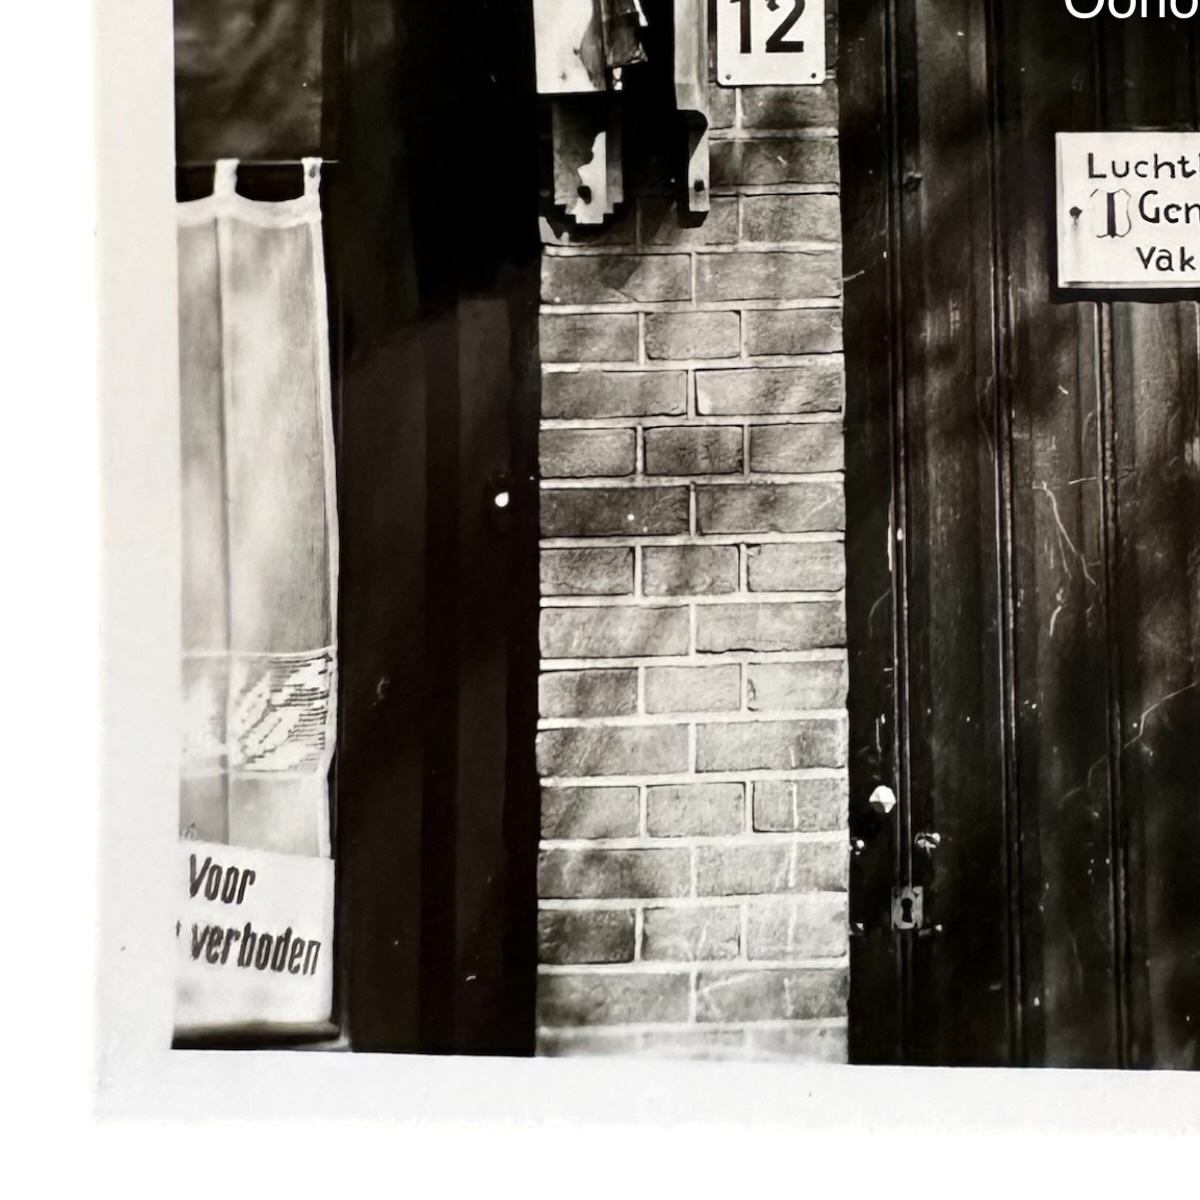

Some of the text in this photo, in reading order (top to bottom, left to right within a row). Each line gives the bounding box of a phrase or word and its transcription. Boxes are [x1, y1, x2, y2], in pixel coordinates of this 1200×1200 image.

[1135, 246, 1196, 272] Vak
[189, 853, 256, 905] Voor
[191, 921, 322, 976] verboden
